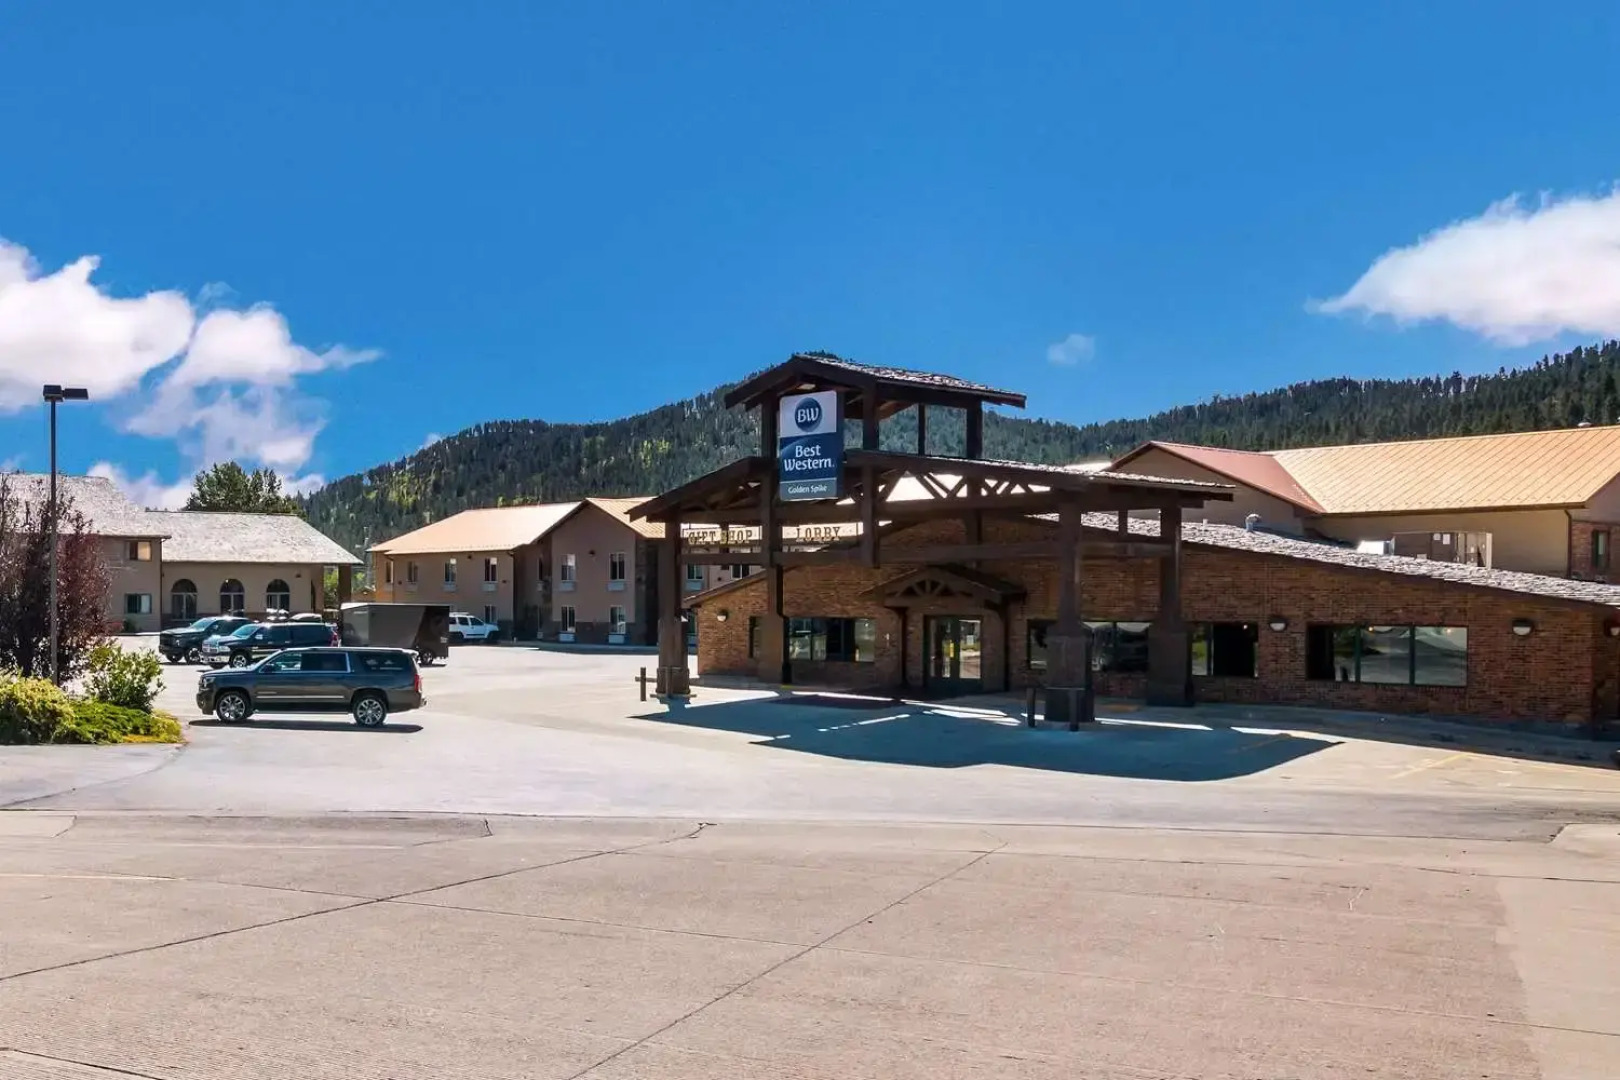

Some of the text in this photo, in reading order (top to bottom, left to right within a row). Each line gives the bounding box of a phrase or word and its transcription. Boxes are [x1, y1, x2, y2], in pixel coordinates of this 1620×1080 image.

[797, 408, 819, 423] BW
[795, 445, 821, 458] Best
[784, 458, 832, 472] Western
[788, 484, 828, 494] Golden Spike
[688, 529, 753, 545] GIFT SHOP
[796, 526, 840, 543] LOBBY
